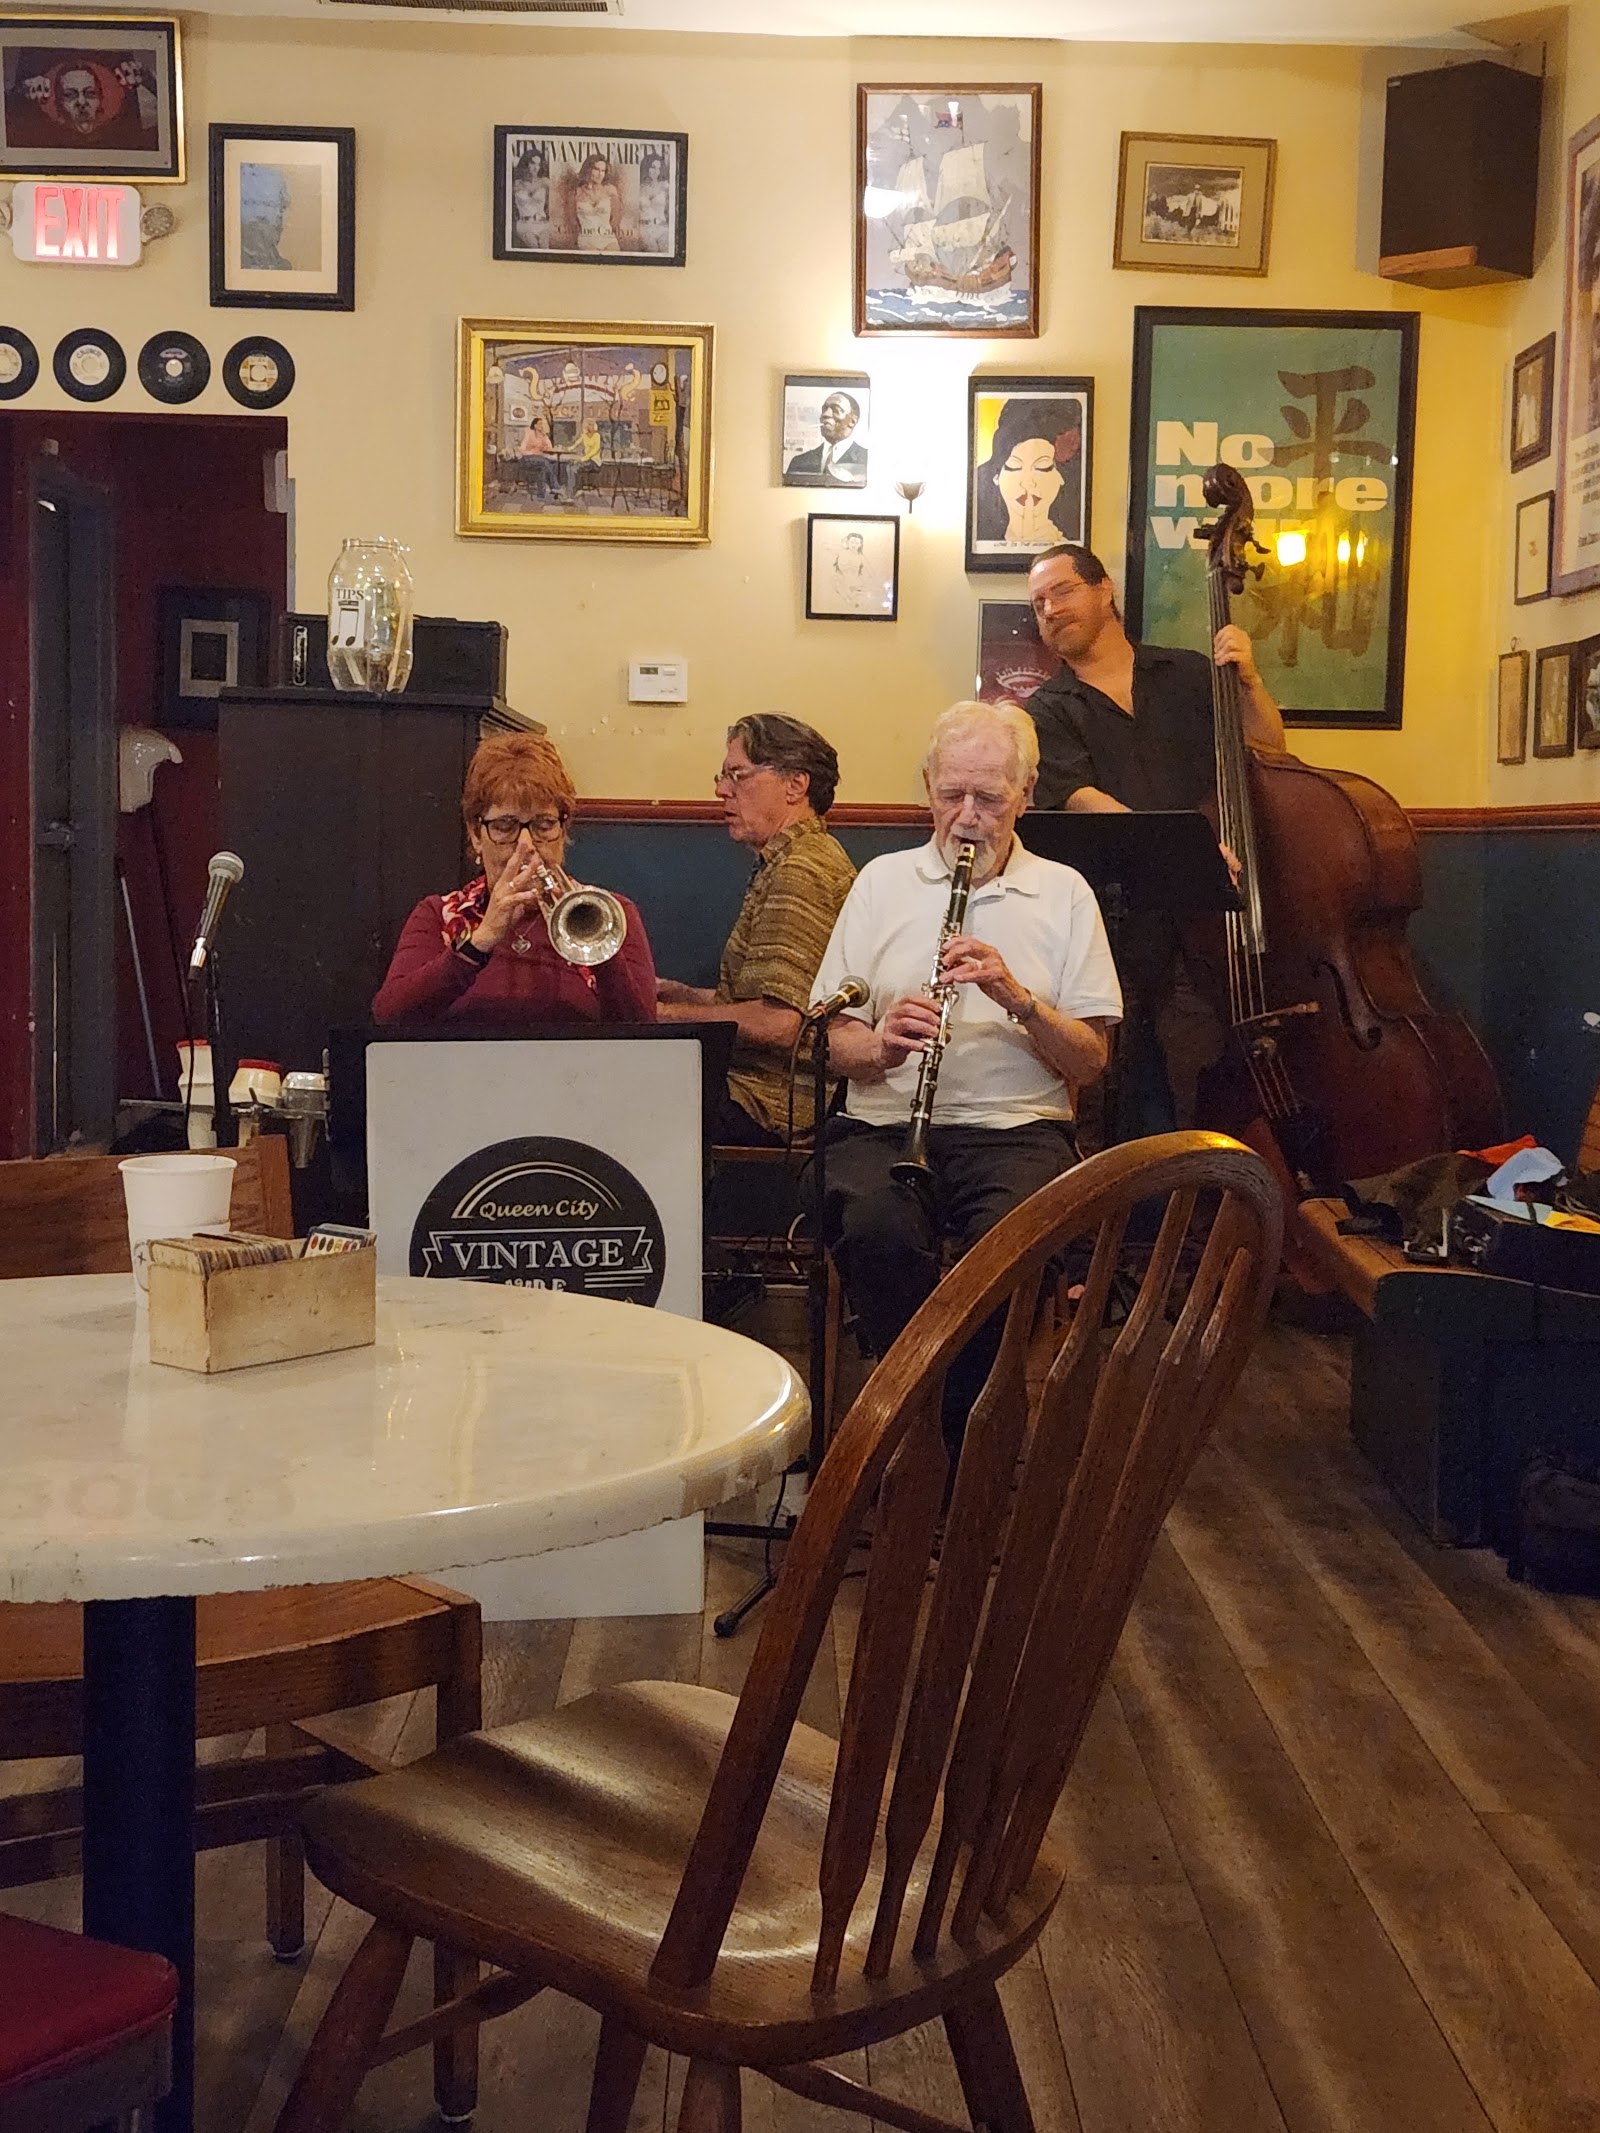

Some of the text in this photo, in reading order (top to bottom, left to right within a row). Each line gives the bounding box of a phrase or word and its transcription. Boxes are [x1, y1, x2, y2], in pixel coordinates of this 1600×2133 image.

[549, 140, 639, 165] VANITY FAIR
[34, 185, 125, 259] EXIT
[1155, 420, 1276, 469] No
[1154, 473, 1388, 512] more
[336, 588, 365, 601] TIPS
[479, 1199, 600, 1221] Queen City
[451, 1238, 624, 1270] VINTAGE
